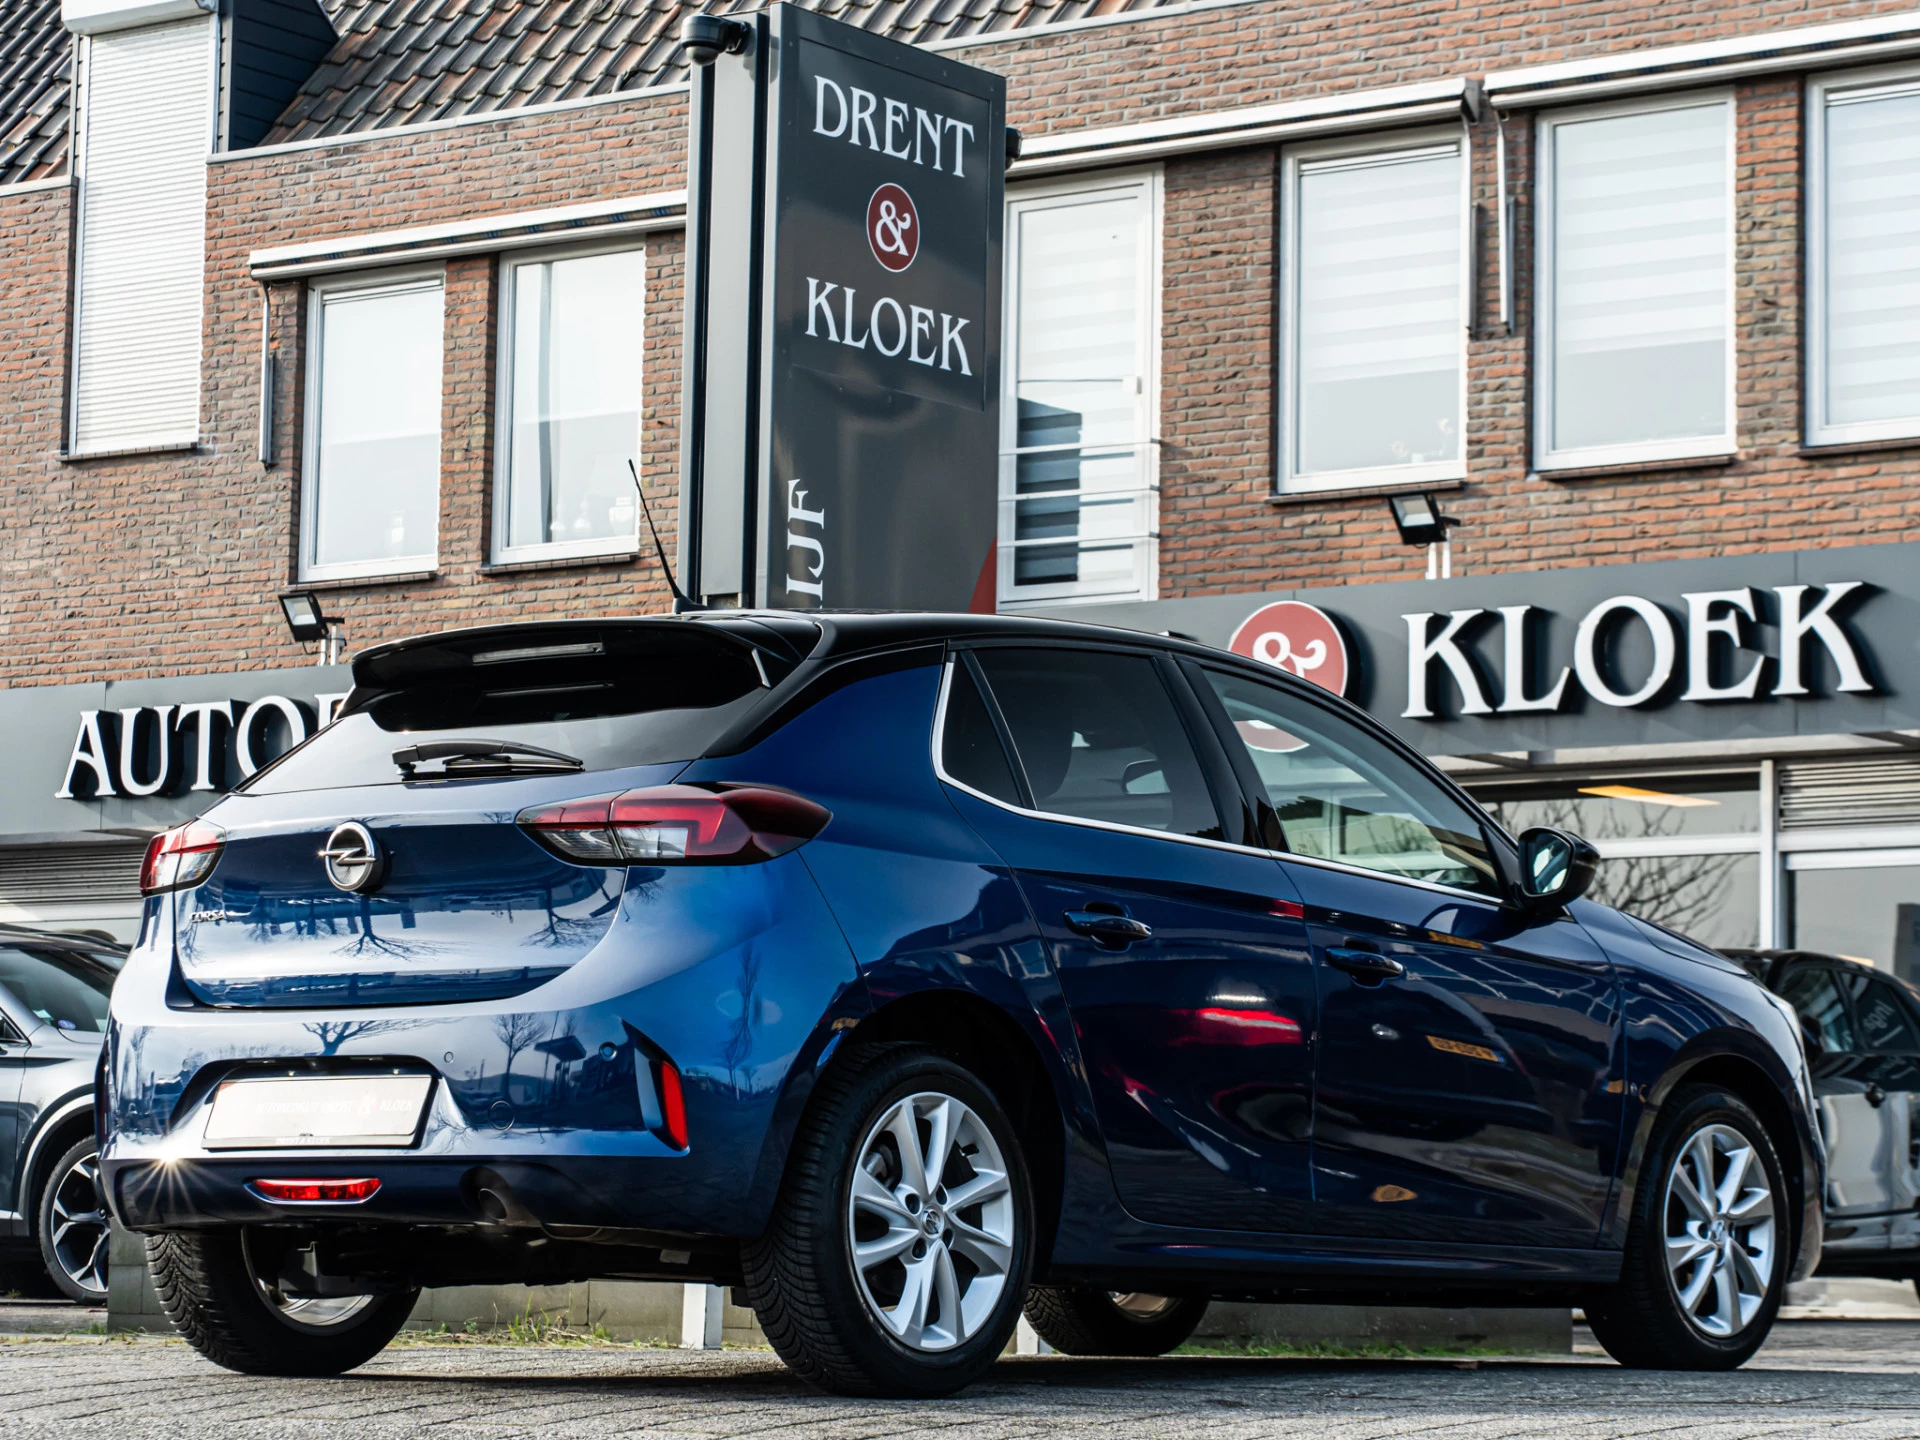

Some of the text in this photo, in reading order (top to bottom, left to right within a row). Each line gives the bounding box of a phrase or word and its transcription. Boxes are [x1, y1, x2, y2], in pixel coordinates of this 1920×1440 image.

[813, 75, 975, 178] DRENT
[876, 200, 911, 257] &
[805, 276, 973, 376] KLOEK
[786, 478, 825, 609] IJF
[1400, 581, 1873, 718] KLOEK
[54, 692, 352, 798] AUTO
